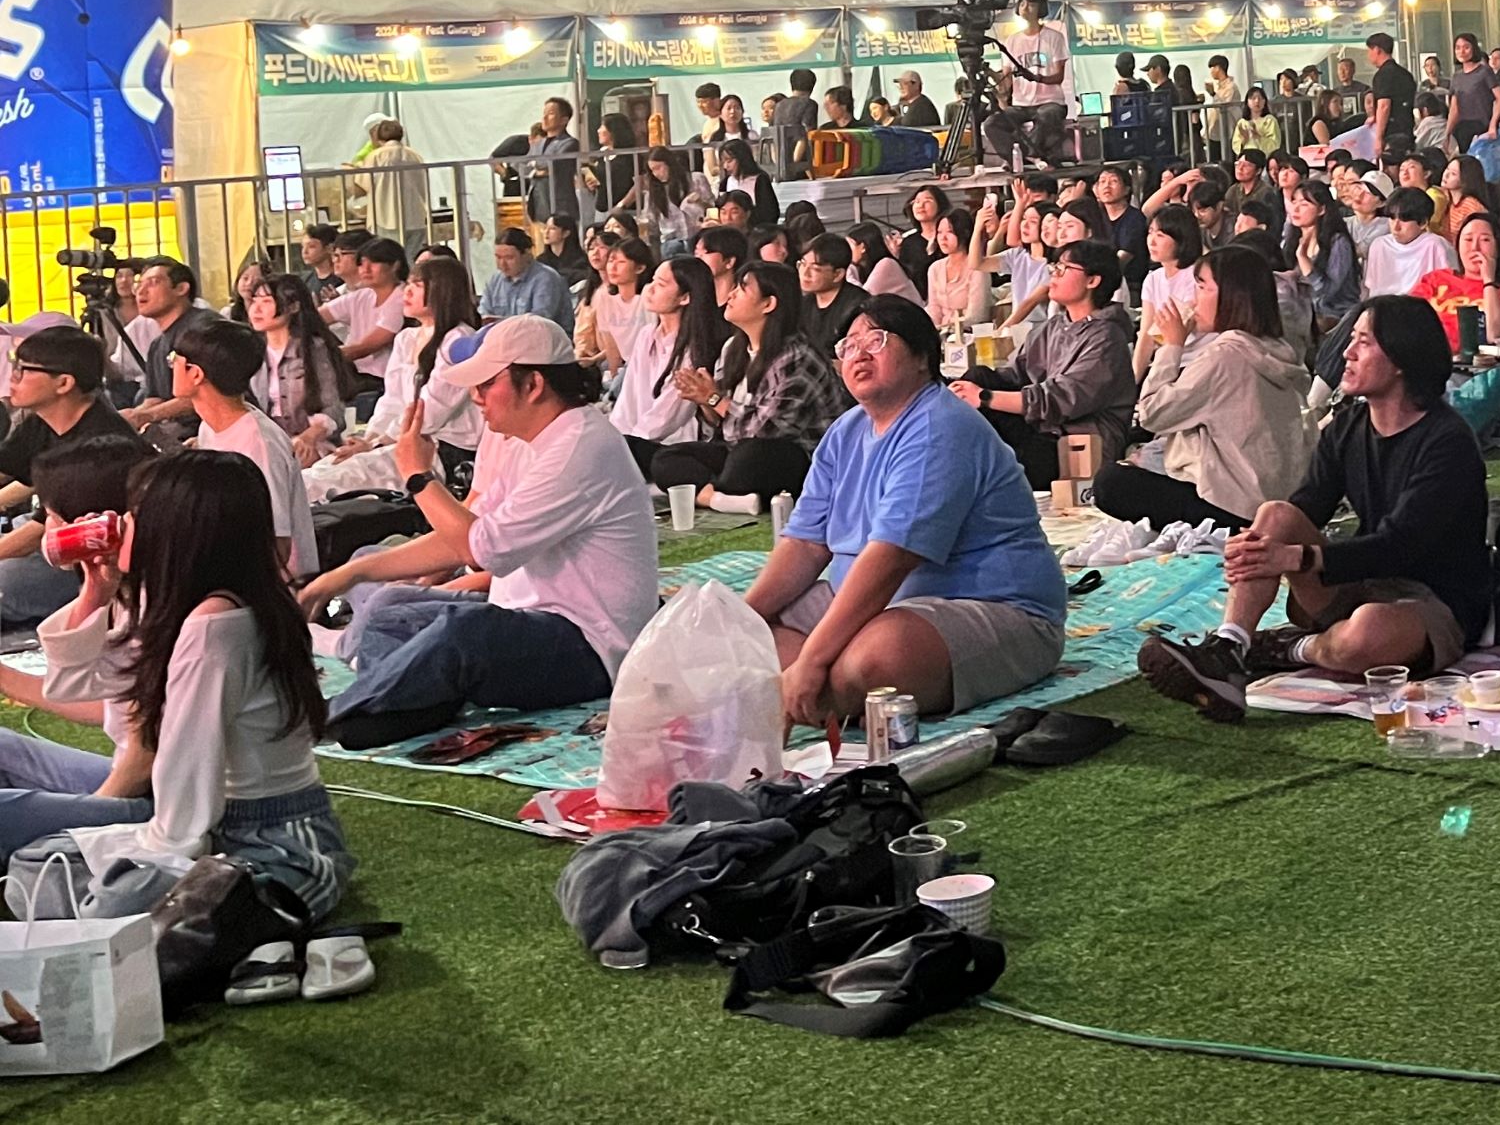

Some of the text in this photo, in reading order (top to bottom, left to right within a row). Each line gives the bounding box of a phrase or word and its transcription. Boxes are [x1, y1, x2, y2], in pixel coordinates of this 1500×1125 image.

[375, 26, 398, 37] 2024
[426, 25, 445, 36] Fest
[447, 24, 487, 37] Gwangju
[593, 40, 620, 68] 터키
